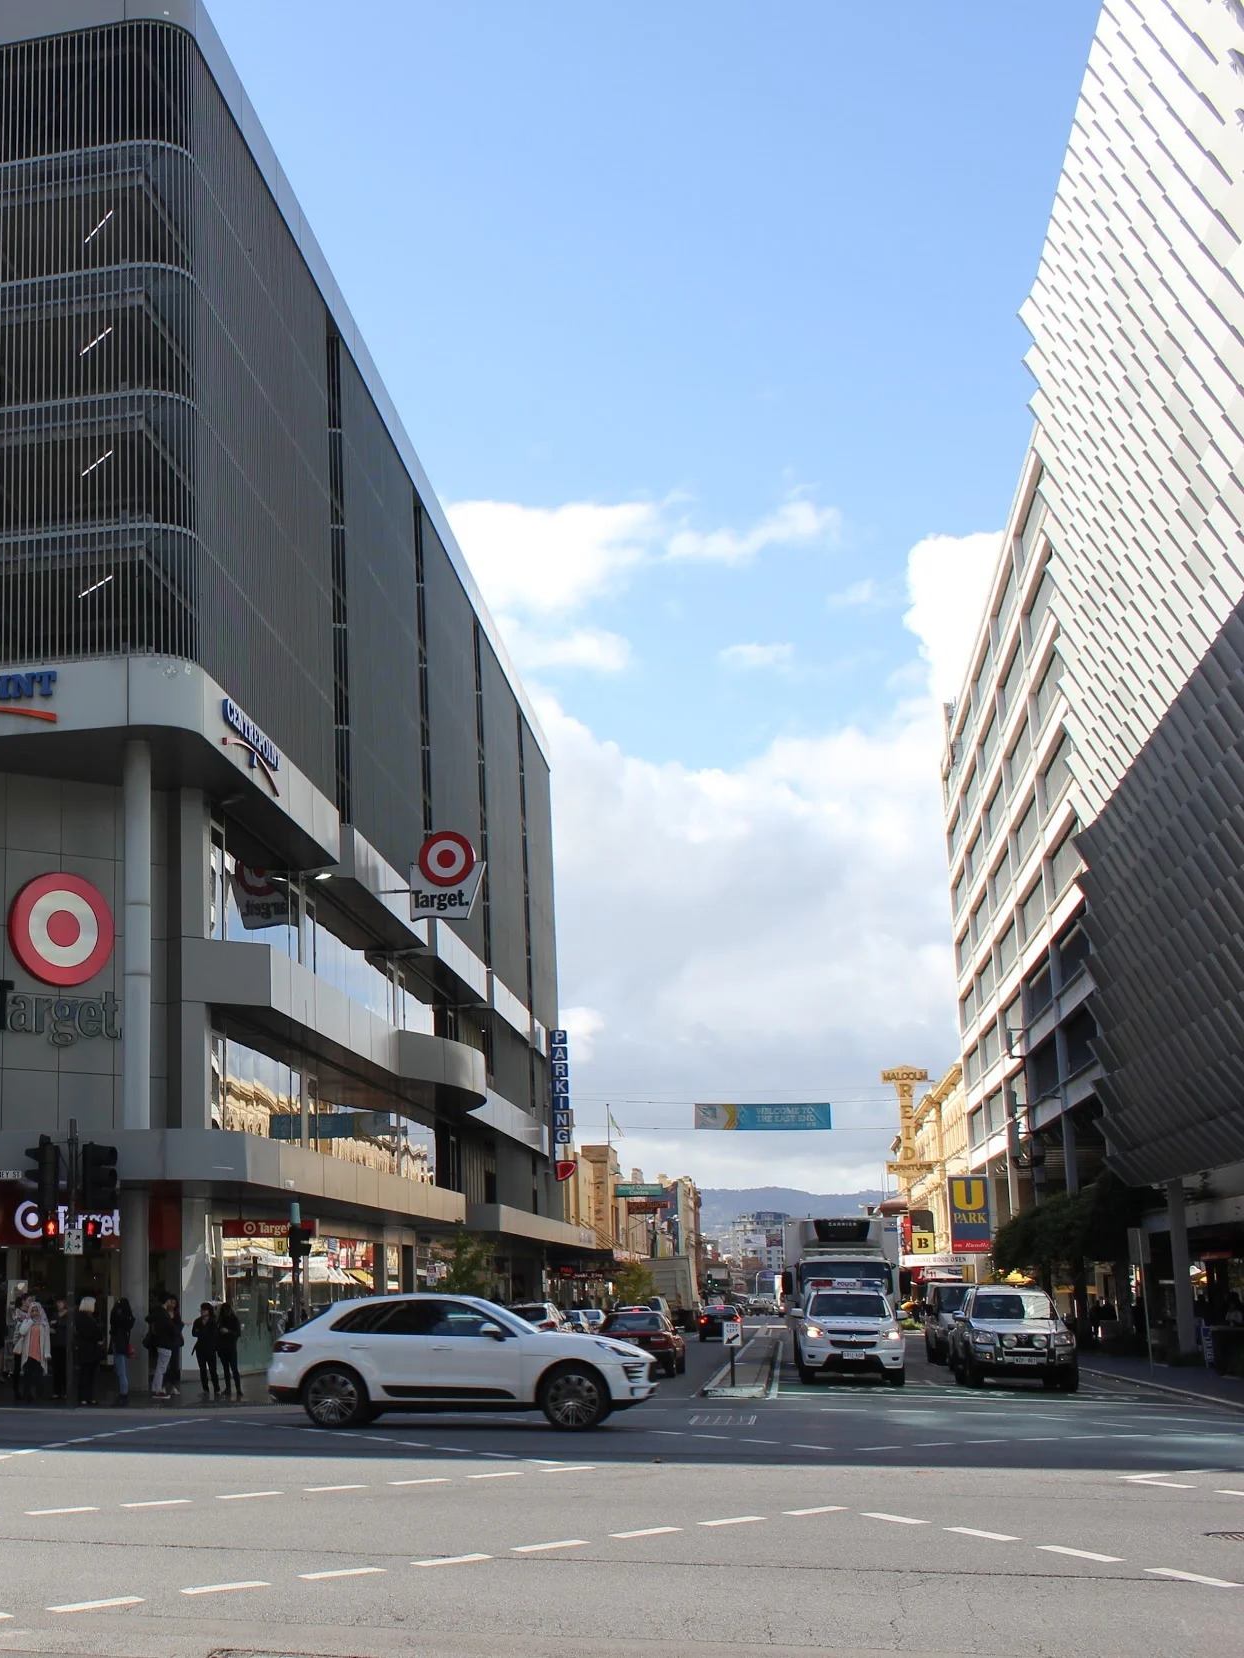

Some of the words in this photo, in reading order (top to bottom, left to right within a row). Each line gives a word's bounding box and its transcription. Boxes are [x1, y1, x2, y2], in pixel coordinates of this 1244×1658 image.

[223, 699, 280, 771] CENTREPOINT
[555, 1031, 569, 1143] PARKING
[882, 1071, 928, 1082] MALCOLM
[756, 1106, 799, 1115] WELCOME
[802, 1106, 814, 1115] TO
[899, 1083, 916, 1161] REID
[952, 1179, 985, 1211] U
[953, 1212, 987, 1224] PARK
[916, 1238, 929, 1249] B
